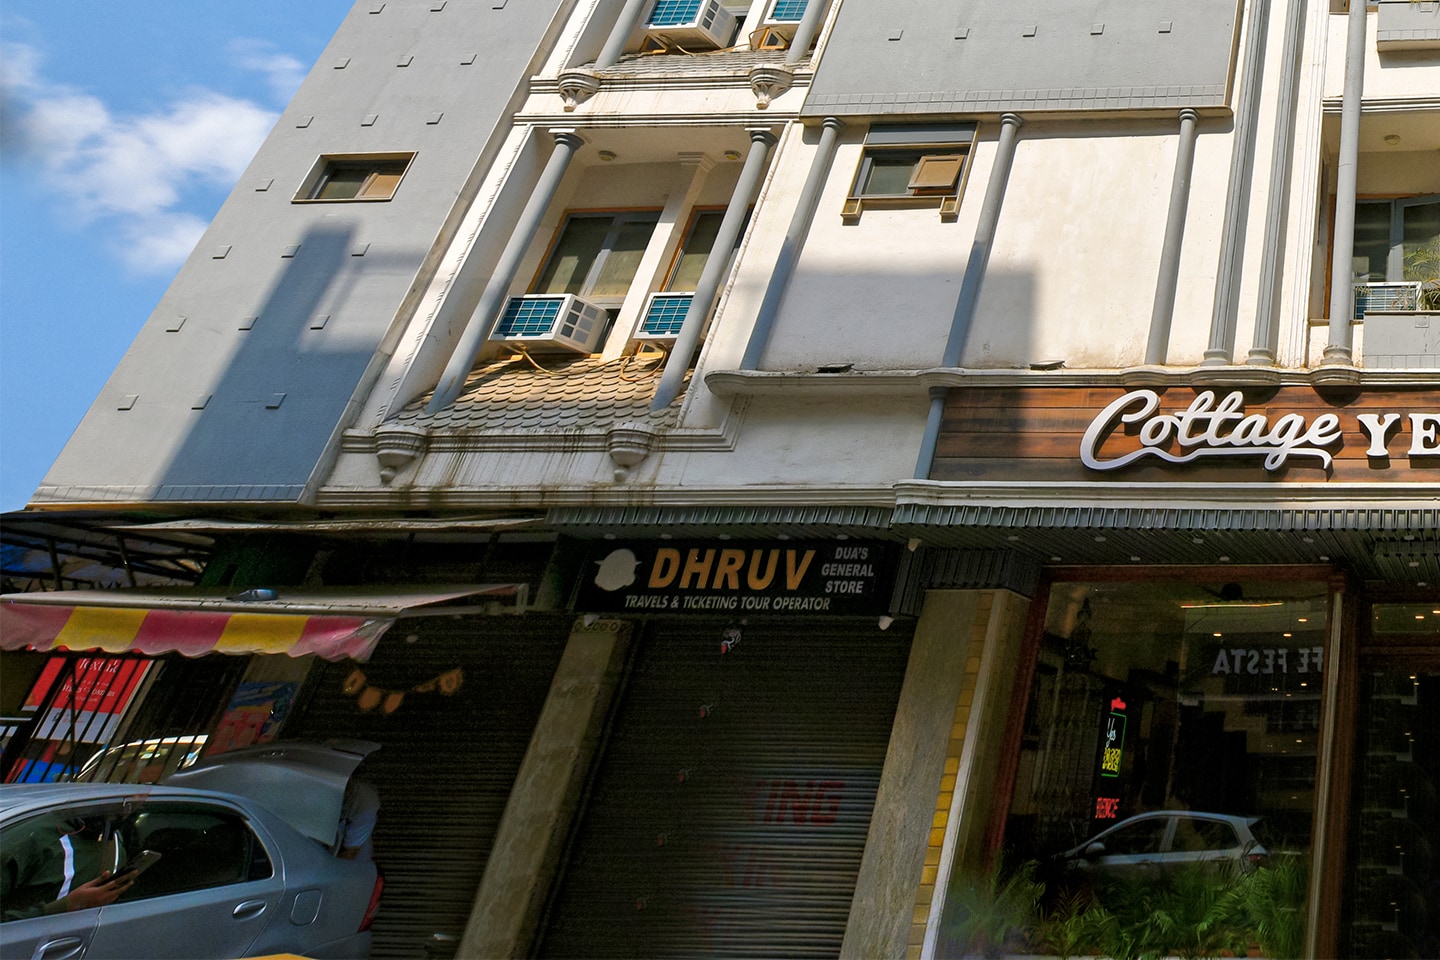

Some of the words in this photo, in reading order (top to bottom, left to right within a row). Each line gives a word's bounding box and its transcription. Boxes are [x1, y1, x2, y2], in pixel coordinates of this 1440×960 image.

[1079, 389, 1342, 471] Cottage
[834, 547, 868, 560] DUA'S
[648, 548, 816, 590] DHRUV
[821, 563, 874, 577] GENERAL
[825, 581, 863, 594] STORE
[624, 595, 669, 609] TRAVELS
[670, 596, 679, 609] &
[682, 595, 738, 610] TICKETING
[741, 596, 770, 610] TOUR
[773, 597, 830, 611] OPERATOR
